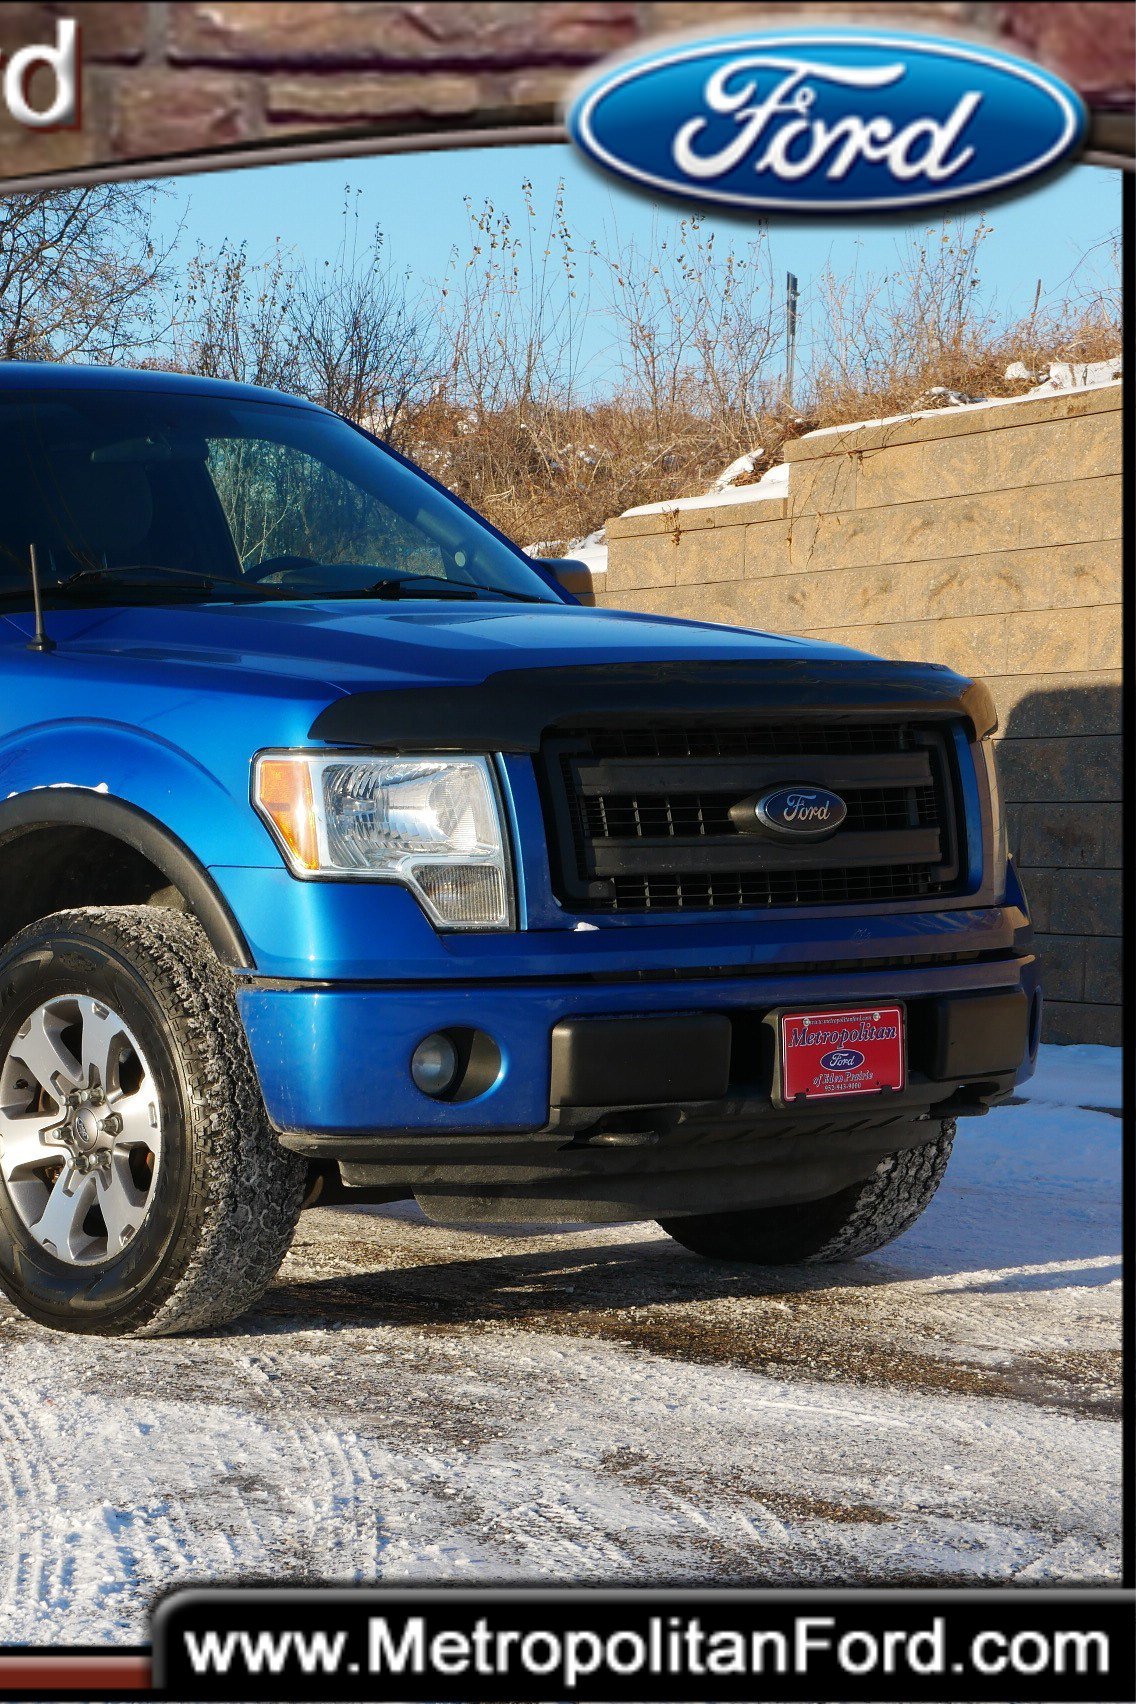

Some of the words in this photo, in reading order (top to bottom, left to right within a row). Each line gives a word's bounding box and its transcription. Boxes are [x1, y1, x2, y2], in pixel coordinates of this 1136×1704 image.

[783, 793, 831, 821] Ford
[788, 1021, 897, 1049] Metropolitan
[829, 1052, 855, 1067] Ford
[813, 1074, 823, 1088] of
[823, 1072, 843, 1084] Eden
[845, 1070, 874, 1082] Prairie
